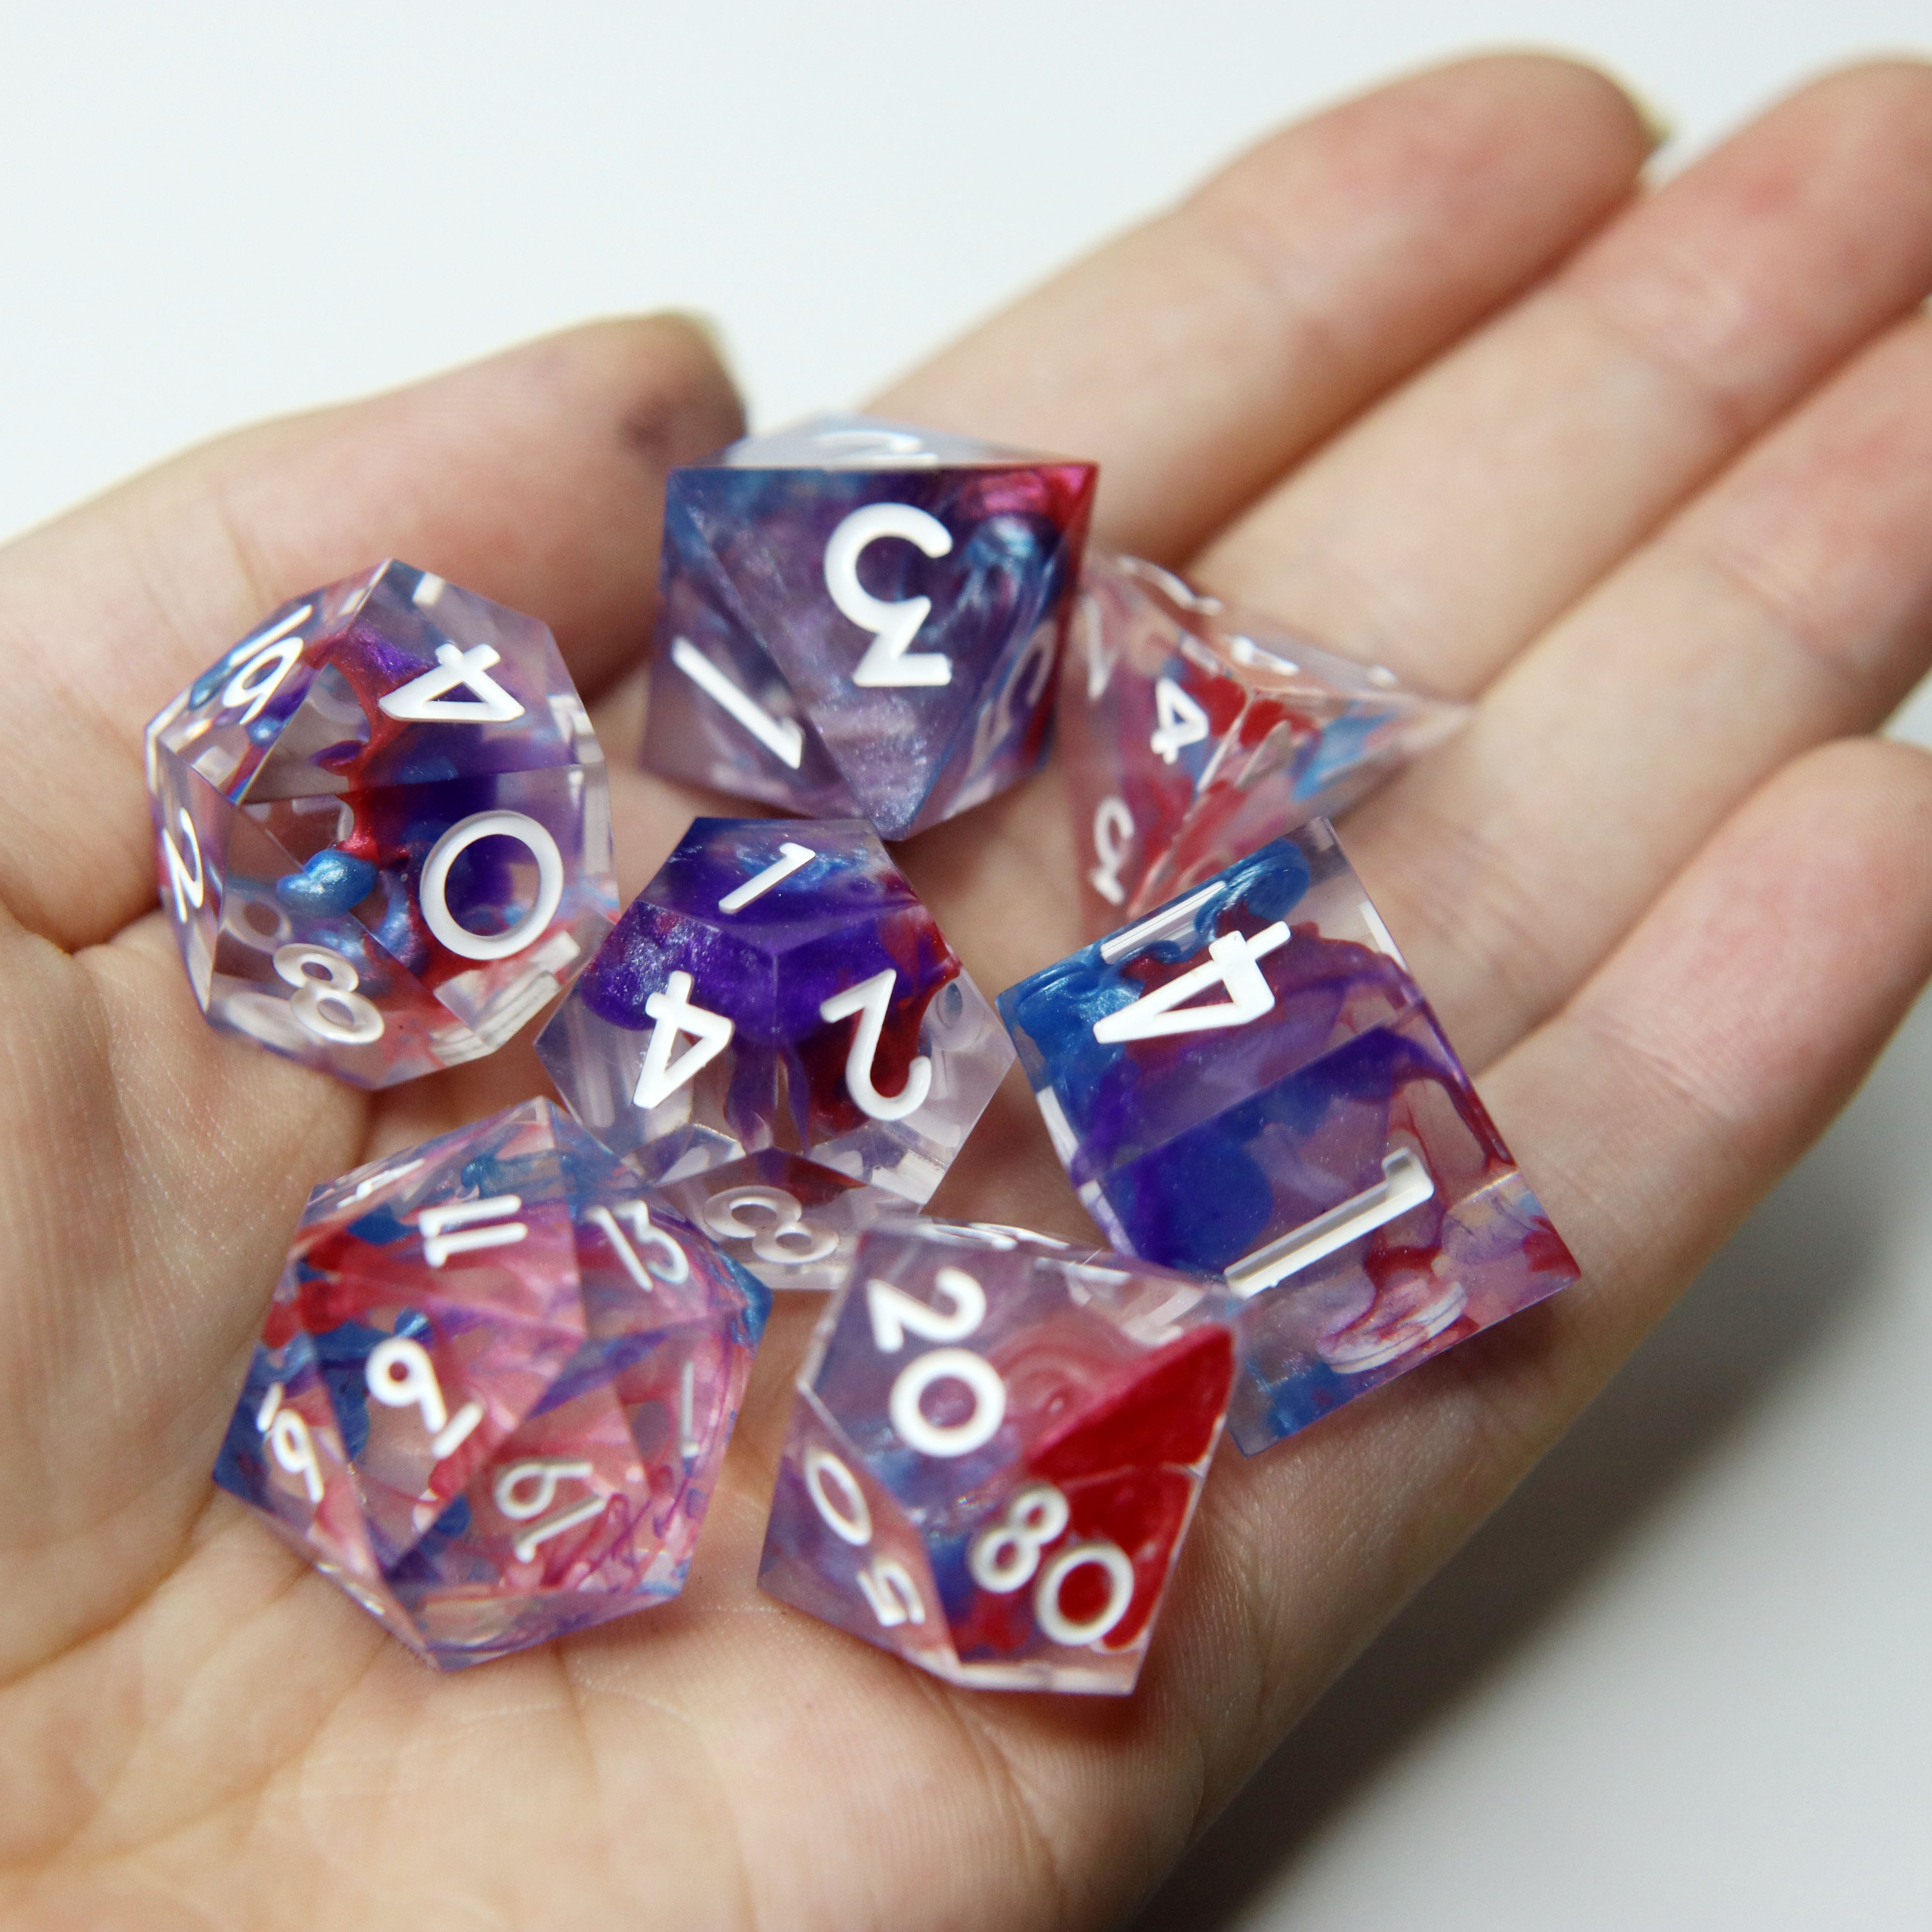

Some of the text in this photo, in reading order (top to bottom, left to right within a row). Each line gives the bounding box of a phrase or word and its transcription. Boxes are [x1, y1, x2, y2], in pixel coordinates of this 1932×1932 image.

[824, 502, 953, 687] 3
[378, 643, 525, 723] 4
[672, 637, 803, 769] 1
[1150, 675, 1209, 765] 4
[419, 810, 563, 960] 0
[719, 842, 816, 914] 1
[272, 942, 385, 1044] 8
[632, 970, 735, 1109] 4
[819, 968, 931, 1122] 2
[1093, 921, 1292, 1044] 4
[416, 1194, 529, 1267] 11
[702, 1184, 840, 1264] 8
[1224, 1147, 1435, 1298] 1
[867, 1265, 1011, 1458] 20
[970, 1484, 1135, 1646] 80
